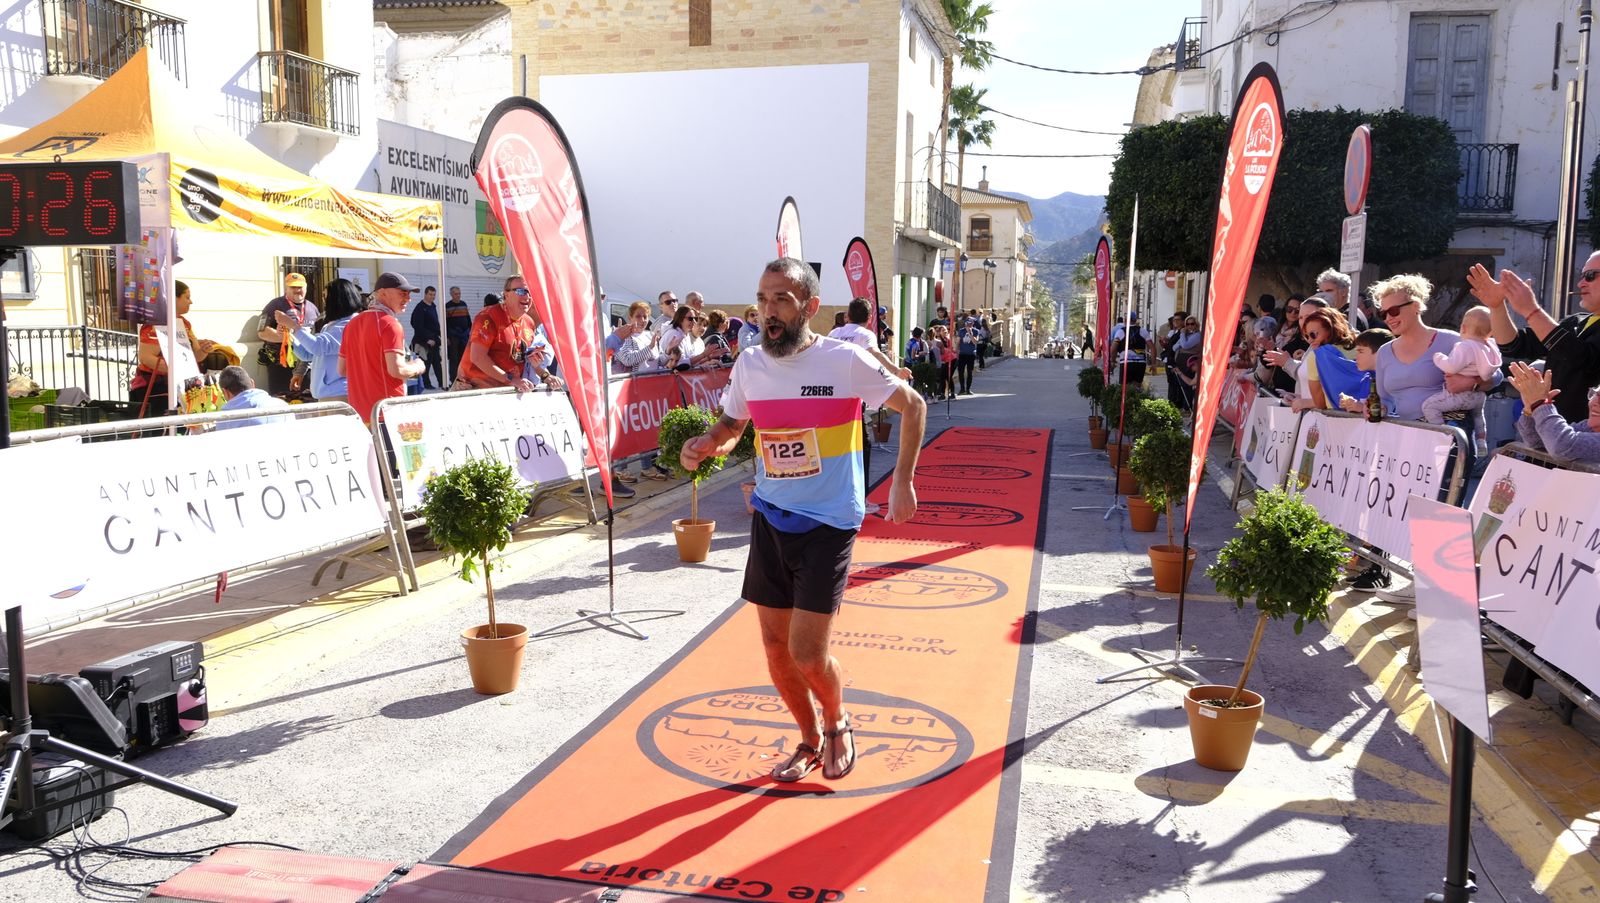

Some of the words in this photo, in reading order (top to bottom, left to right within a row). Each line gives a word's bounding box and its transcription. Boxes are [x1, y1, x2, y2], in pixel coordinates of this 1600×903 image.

[388, 147, 470, 180] EXCELENTÍSIMO
[390, 176, 469, 206] AYUNTAMIENTO
[800, 385, 834, 397] 226ERS
[769, 441, 806, 459] 122
[100, 453, 319, 502] AYUNTAMIENTO
[329, 446, 353, 466] DE
[1416, 464, 1432, 484] DE
[1311, 463, 1426, 521] CANTORI
[103, 470, 366, 555] CANTORIA
[1495, 533, 1600, 631] CANT
[891, 713, 937, 728] LA
[578, 860, 773, 900] Cantoria
